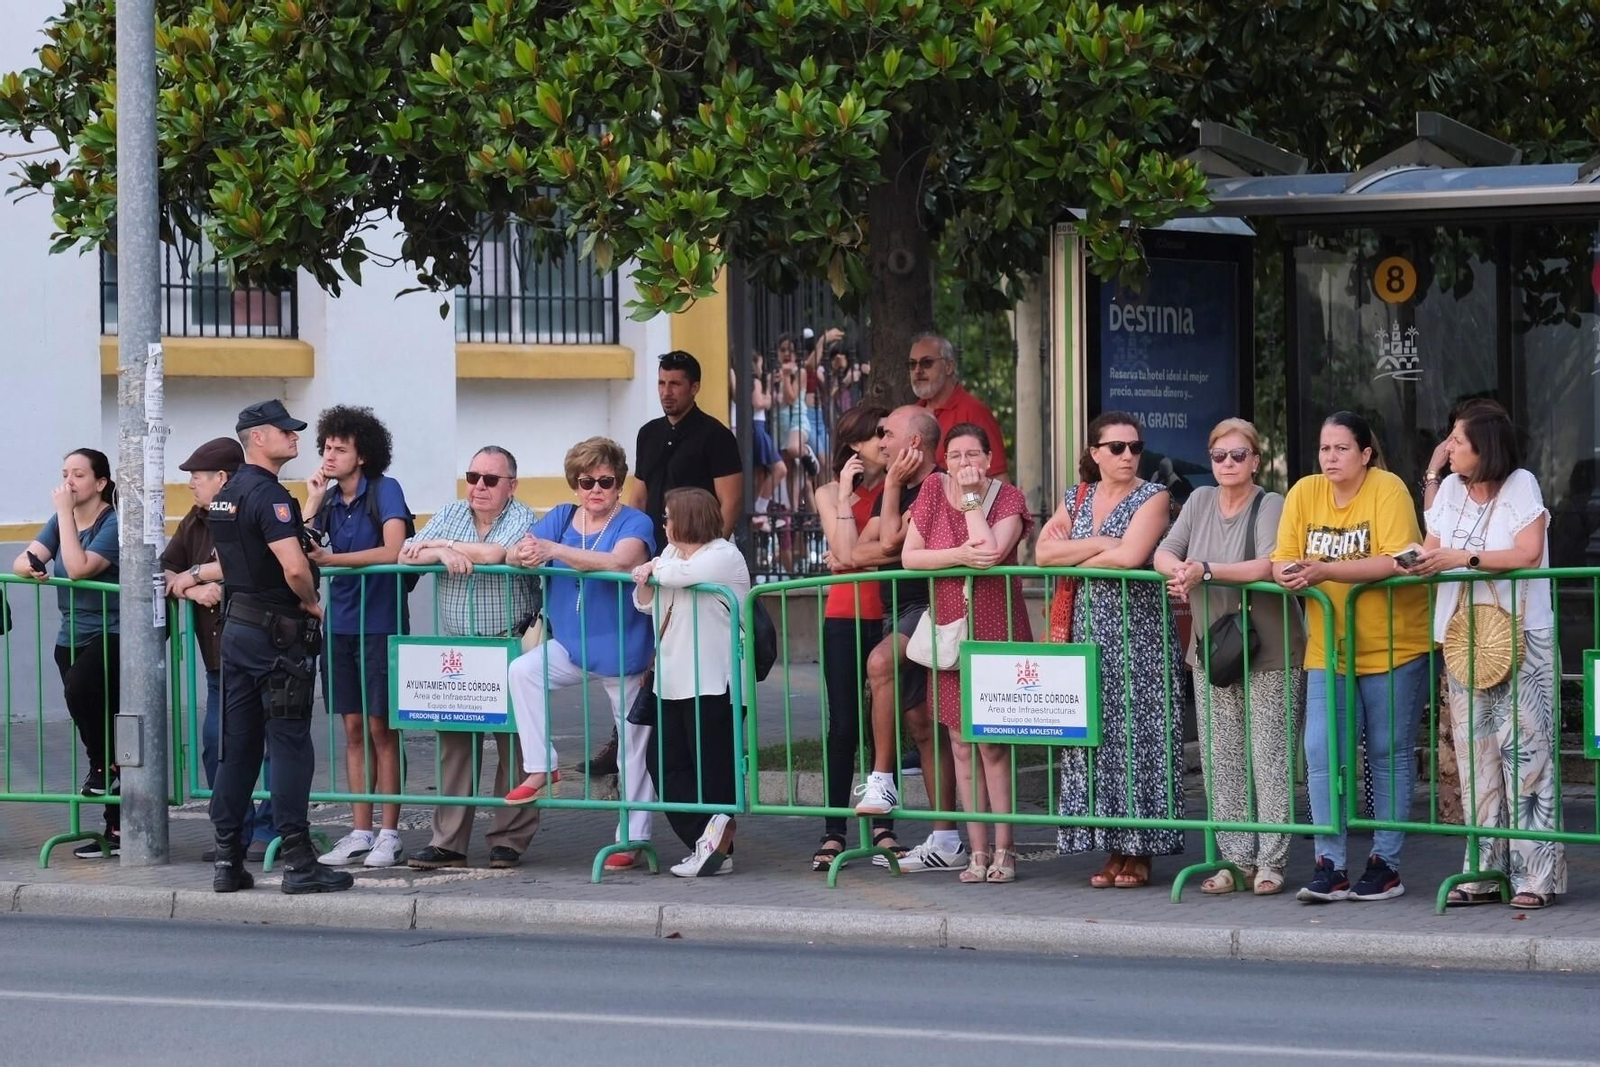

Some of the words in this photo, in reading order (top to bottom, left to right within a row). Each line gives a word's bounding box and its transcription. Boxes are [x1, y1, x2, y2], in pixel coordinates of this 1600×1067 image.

[1385, 265, 1405, 294] 8
[1109, 367, 1138, 380] Reserva
[1138, 368, 1147, 380] tu
[1147, 367, 1166, 381] hotel
[1166, 369, 1183, 382] ideal
[1183, 370, 1189, 382] al
[1189, 371, 1209, 385] mejor
[1109, 385, 1134, 398] precio,
[1135, 386, 1162, 398] acumula
[1163, 386, 1184, 399] dinero
[1148, 412, 1188, 429] GRATIS!
[208, 501, 232, 511] POLICIA
[406, 680, 457, 691] AYUNTAMIENTO
[458, 681, 467, 691] DE
[468, 680, 501, 692] CÓRDOBA
[413, 692, 431, 700] Área
[432, 693, 440, 701] de
[443, 693, 498, 702] Infraestructuras
[980, 693, 1032, 703] AYUNTAMIENTO
[1033, 693, 1043, 704] DE
[1045, 692, 1079, 704] CÓRDOBA
[427, 702, 447, 711] Equipo
[457, 704, 483, 712] Montajes
[988, 704, 1005, 713] Área
[1007, 706, 1016, 714] de
[1019, 705, 1076, 715] Infraestructuras
[409, 712, 440, 720] PERDONEN
[441, 713, 452, 721] LAS
[453, 713, 485, 722] MOLESTIAS
[1003, 715, 1023, 724] Equipo
[1033, 716, 1060, 725] Montajes
[1017, 727, 1028, 735] LAS
[1030, 728, 1064, 736] MOLESTIAS
